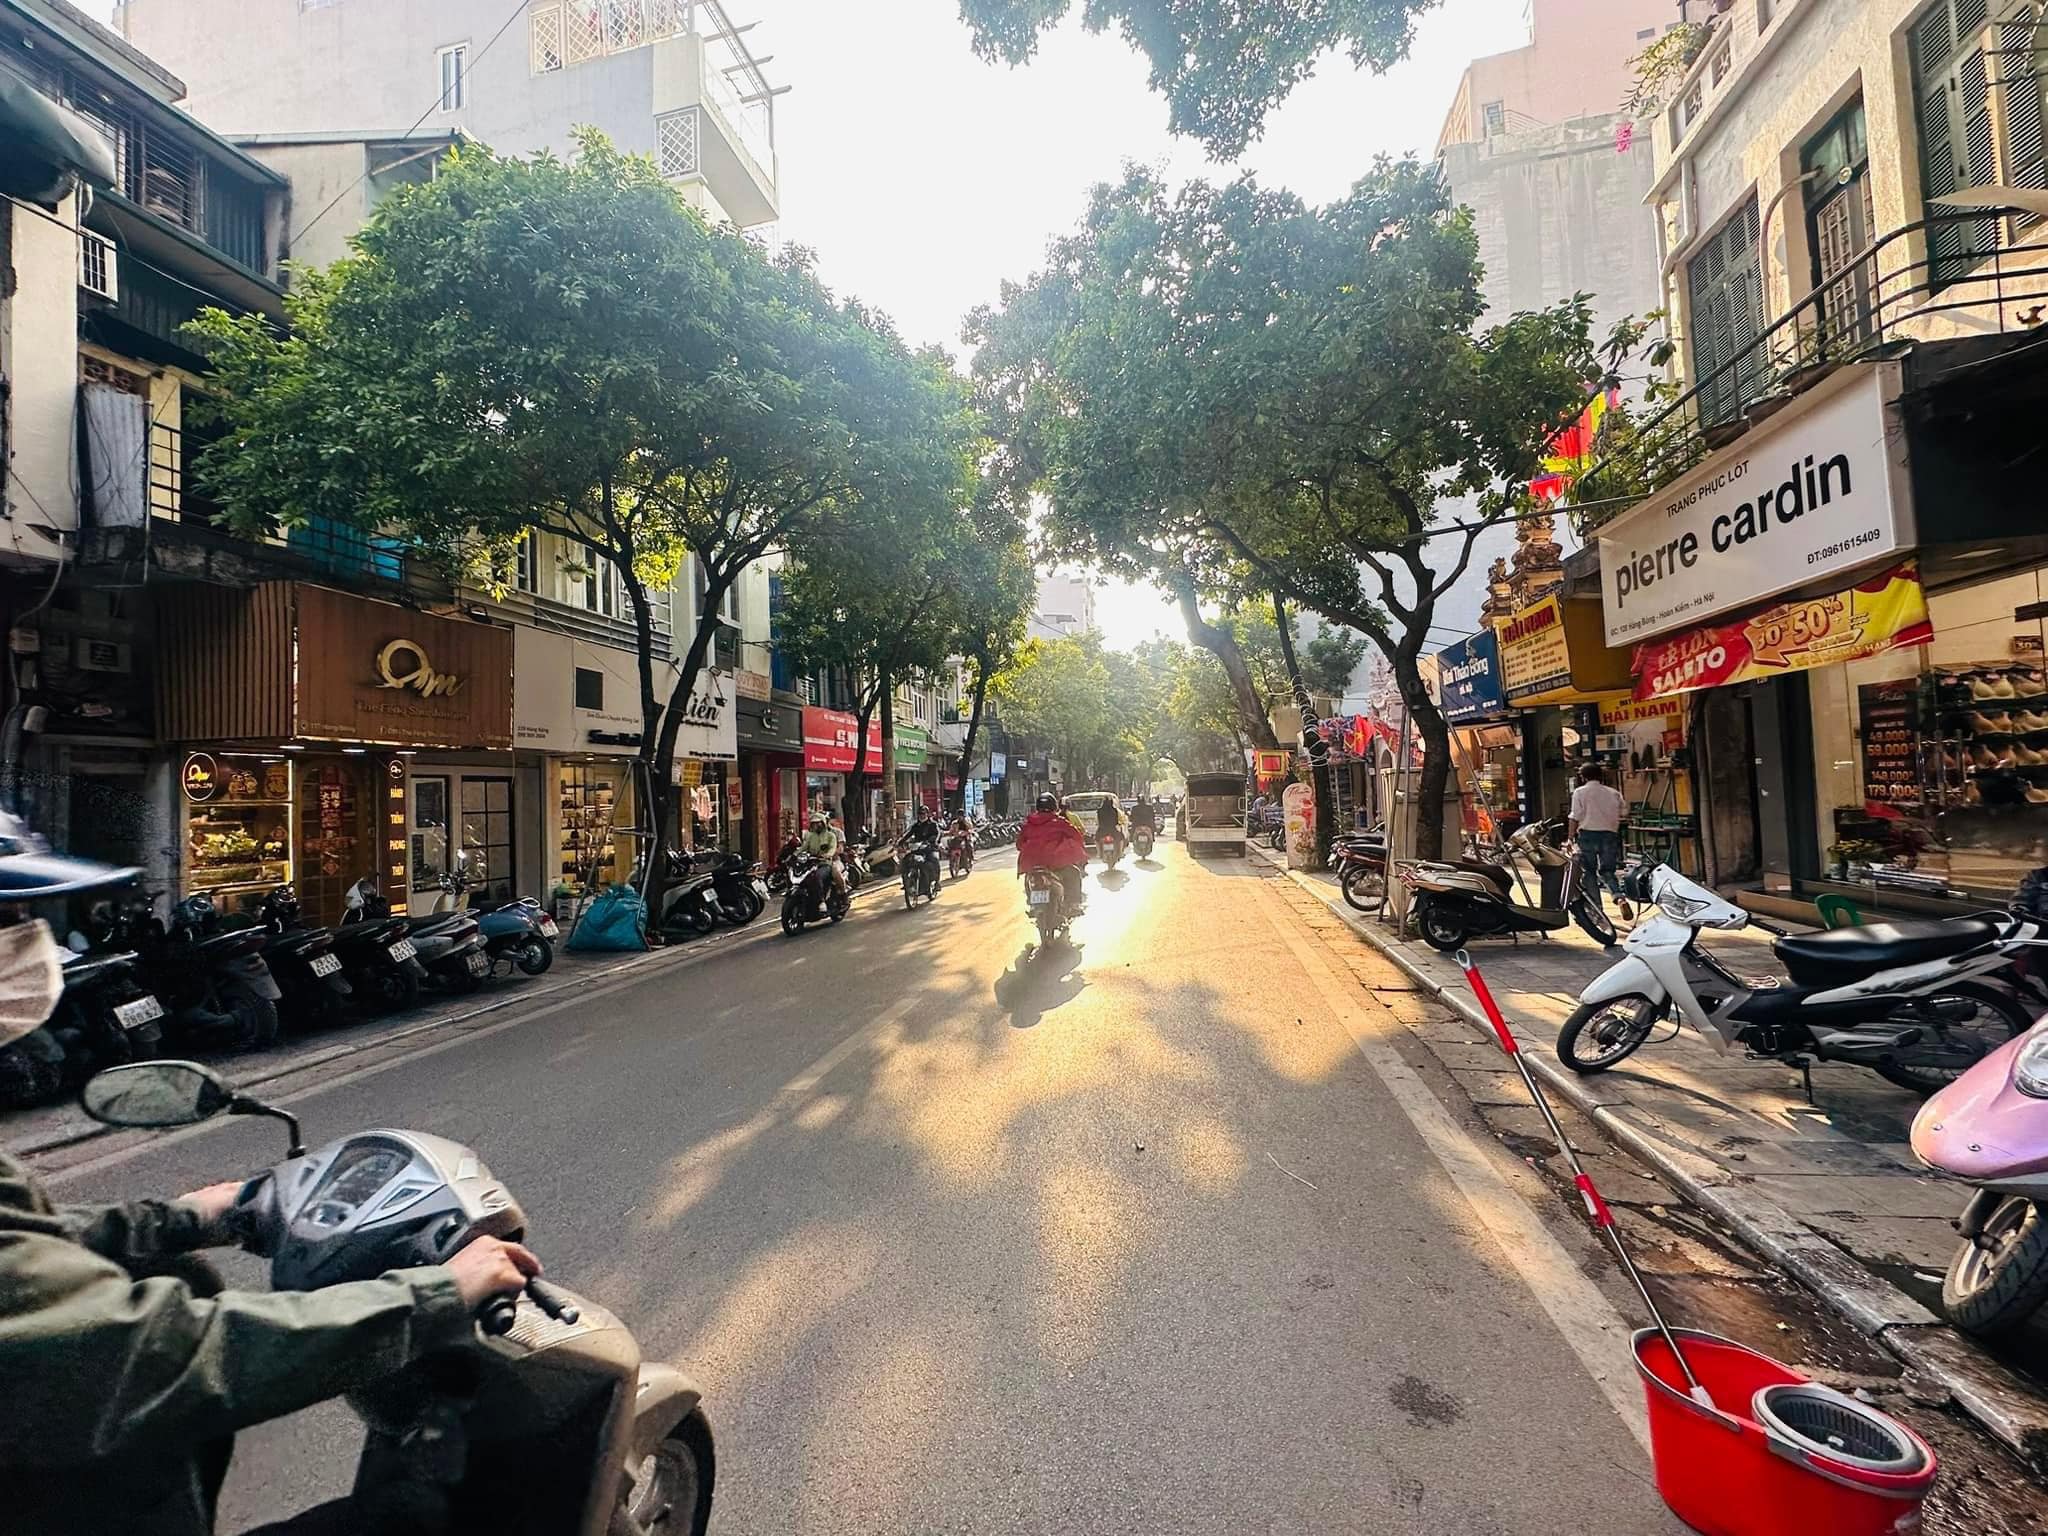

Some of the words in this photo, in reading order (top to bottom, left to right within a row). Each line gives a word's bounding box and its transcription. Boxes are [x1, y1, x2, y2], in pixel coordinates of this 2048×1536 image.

[1666, 492, 1697, 518] TRANG
[1698, 475, 1726, 500] PHỤC
[1616, 532, 1698, 609] pierre
[1711, 453, 1852, 553] cardin
[1807, 528, 1881, 564] ĐT:0961615409
[1603, 706, 1629, 724] HẢI
[1634, 700, 1678, 719] NAM
